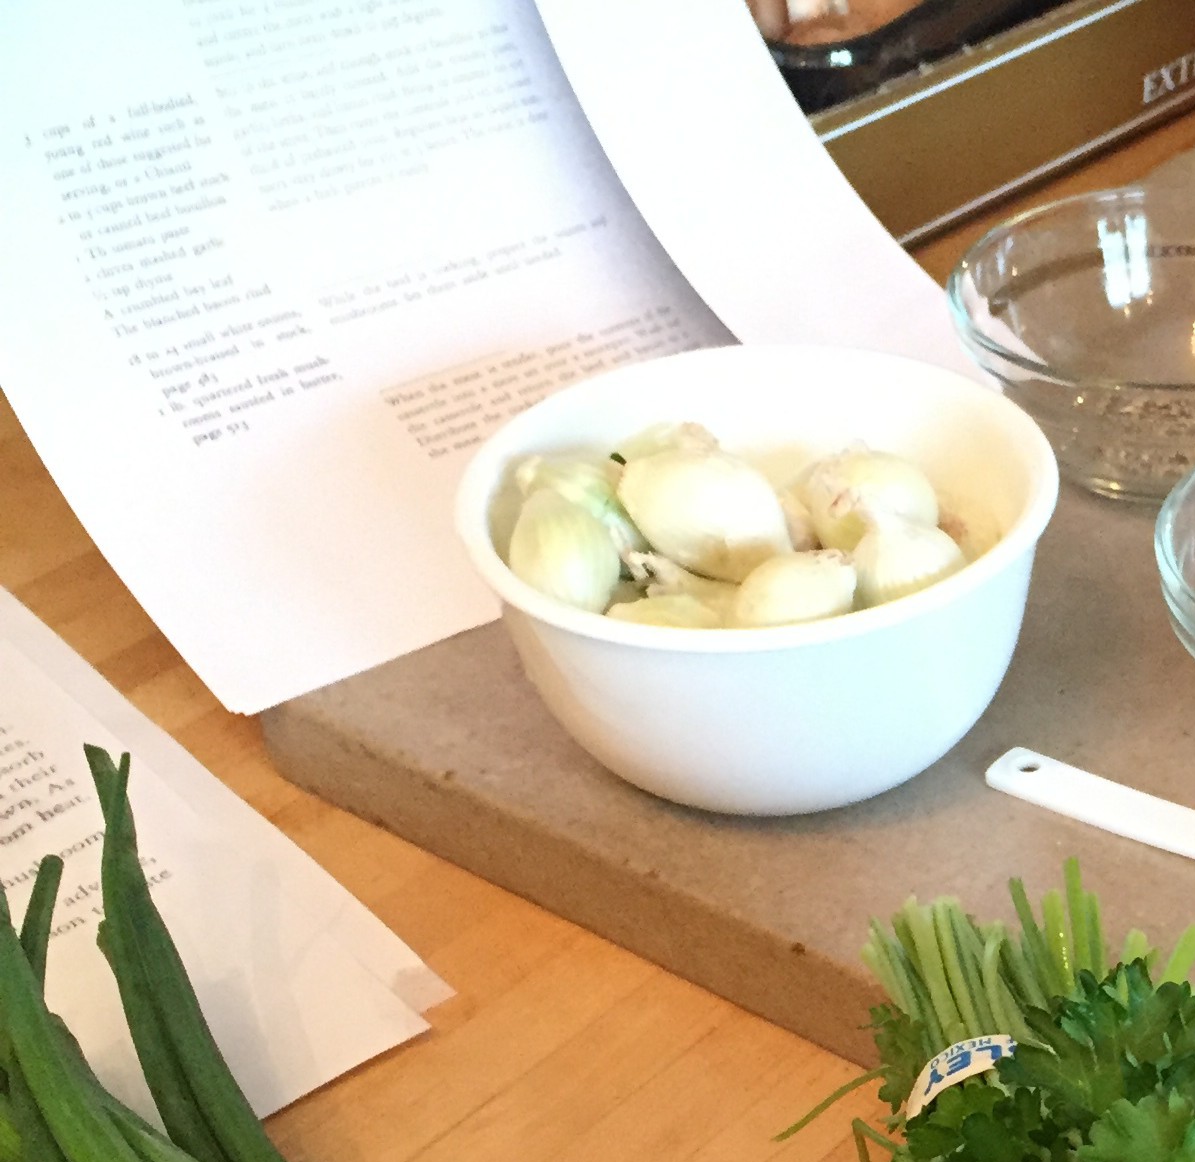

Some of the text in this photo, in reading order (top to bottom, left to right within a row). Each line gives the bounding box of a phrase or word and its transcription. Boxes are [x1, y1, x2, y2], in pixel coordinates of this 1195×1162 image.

[42, 124, 71, 139] cups
[92, 133, 113, 149] red
[120, 128, 150, 142] wine
[53, 168, 75, 181] one
[120, 290, 180, 315] crumbled
[142, 304, 201, 330] blanched
[9, 764, 57, 792] their
[923, 1045, 1003, 1096] LEY
